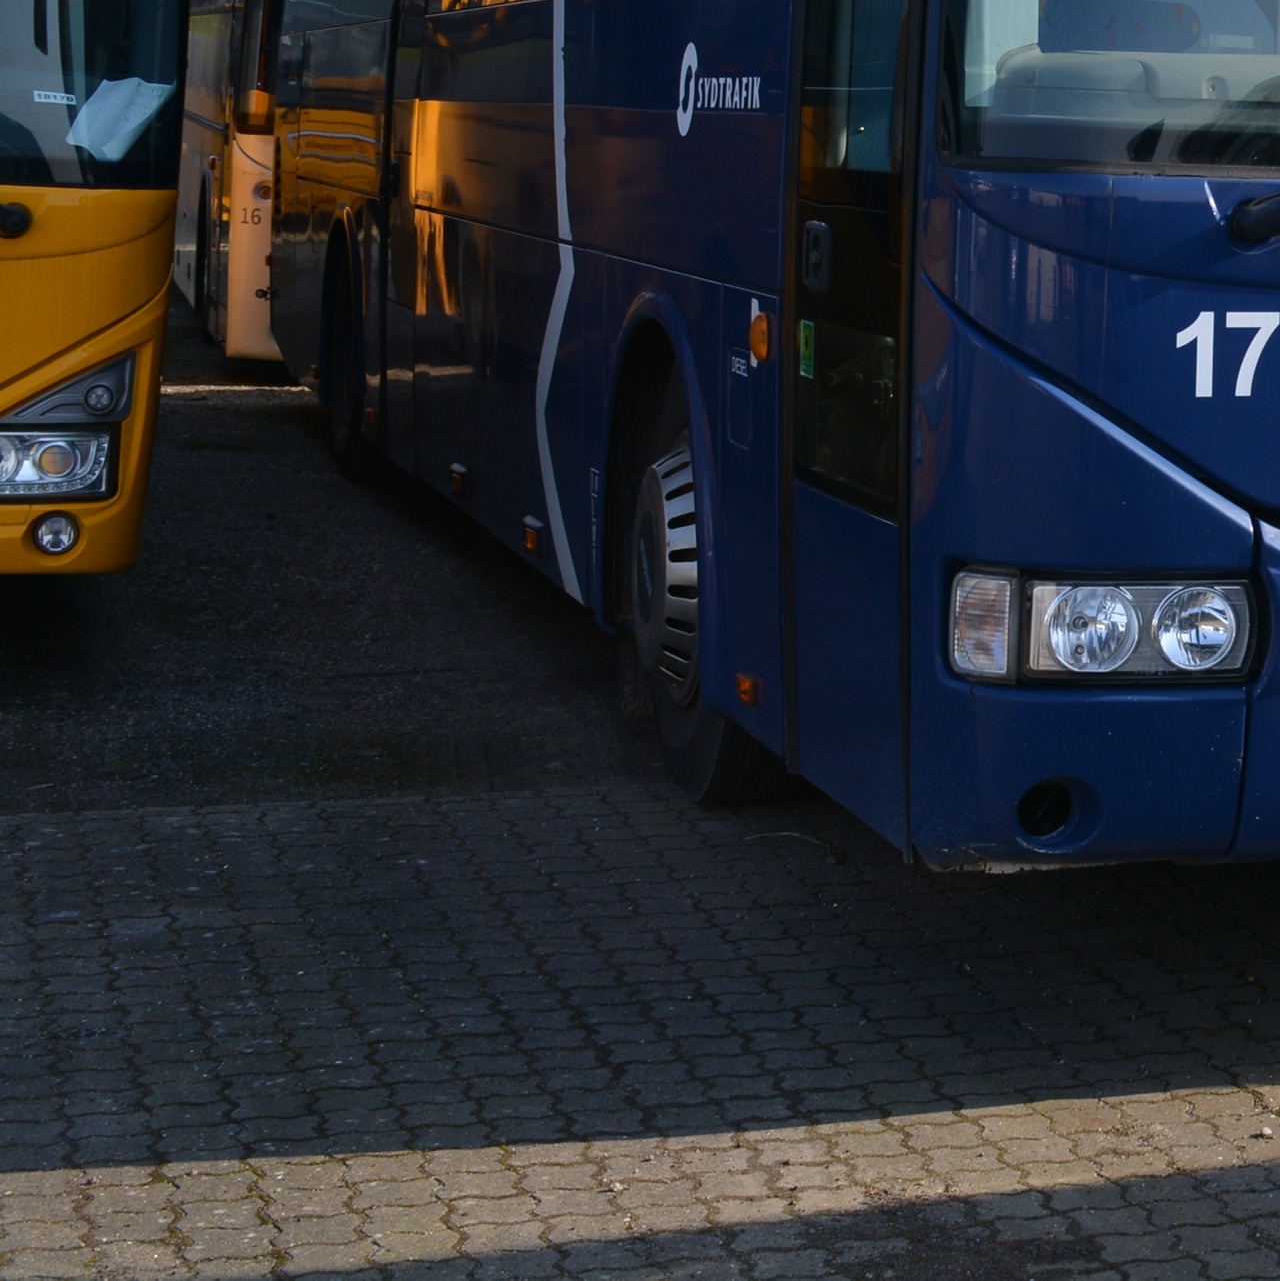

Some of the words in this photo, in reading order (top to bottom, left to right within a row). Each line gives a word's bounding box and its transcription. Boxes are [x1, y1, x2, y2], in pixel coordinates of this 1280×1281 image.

[35, 92, 74, 103] 18170
[697, 76, 761, 109] SYDTRAFIK
[241, 208, 261, 225] 16
[1176, 311, 1280, 398] 17
